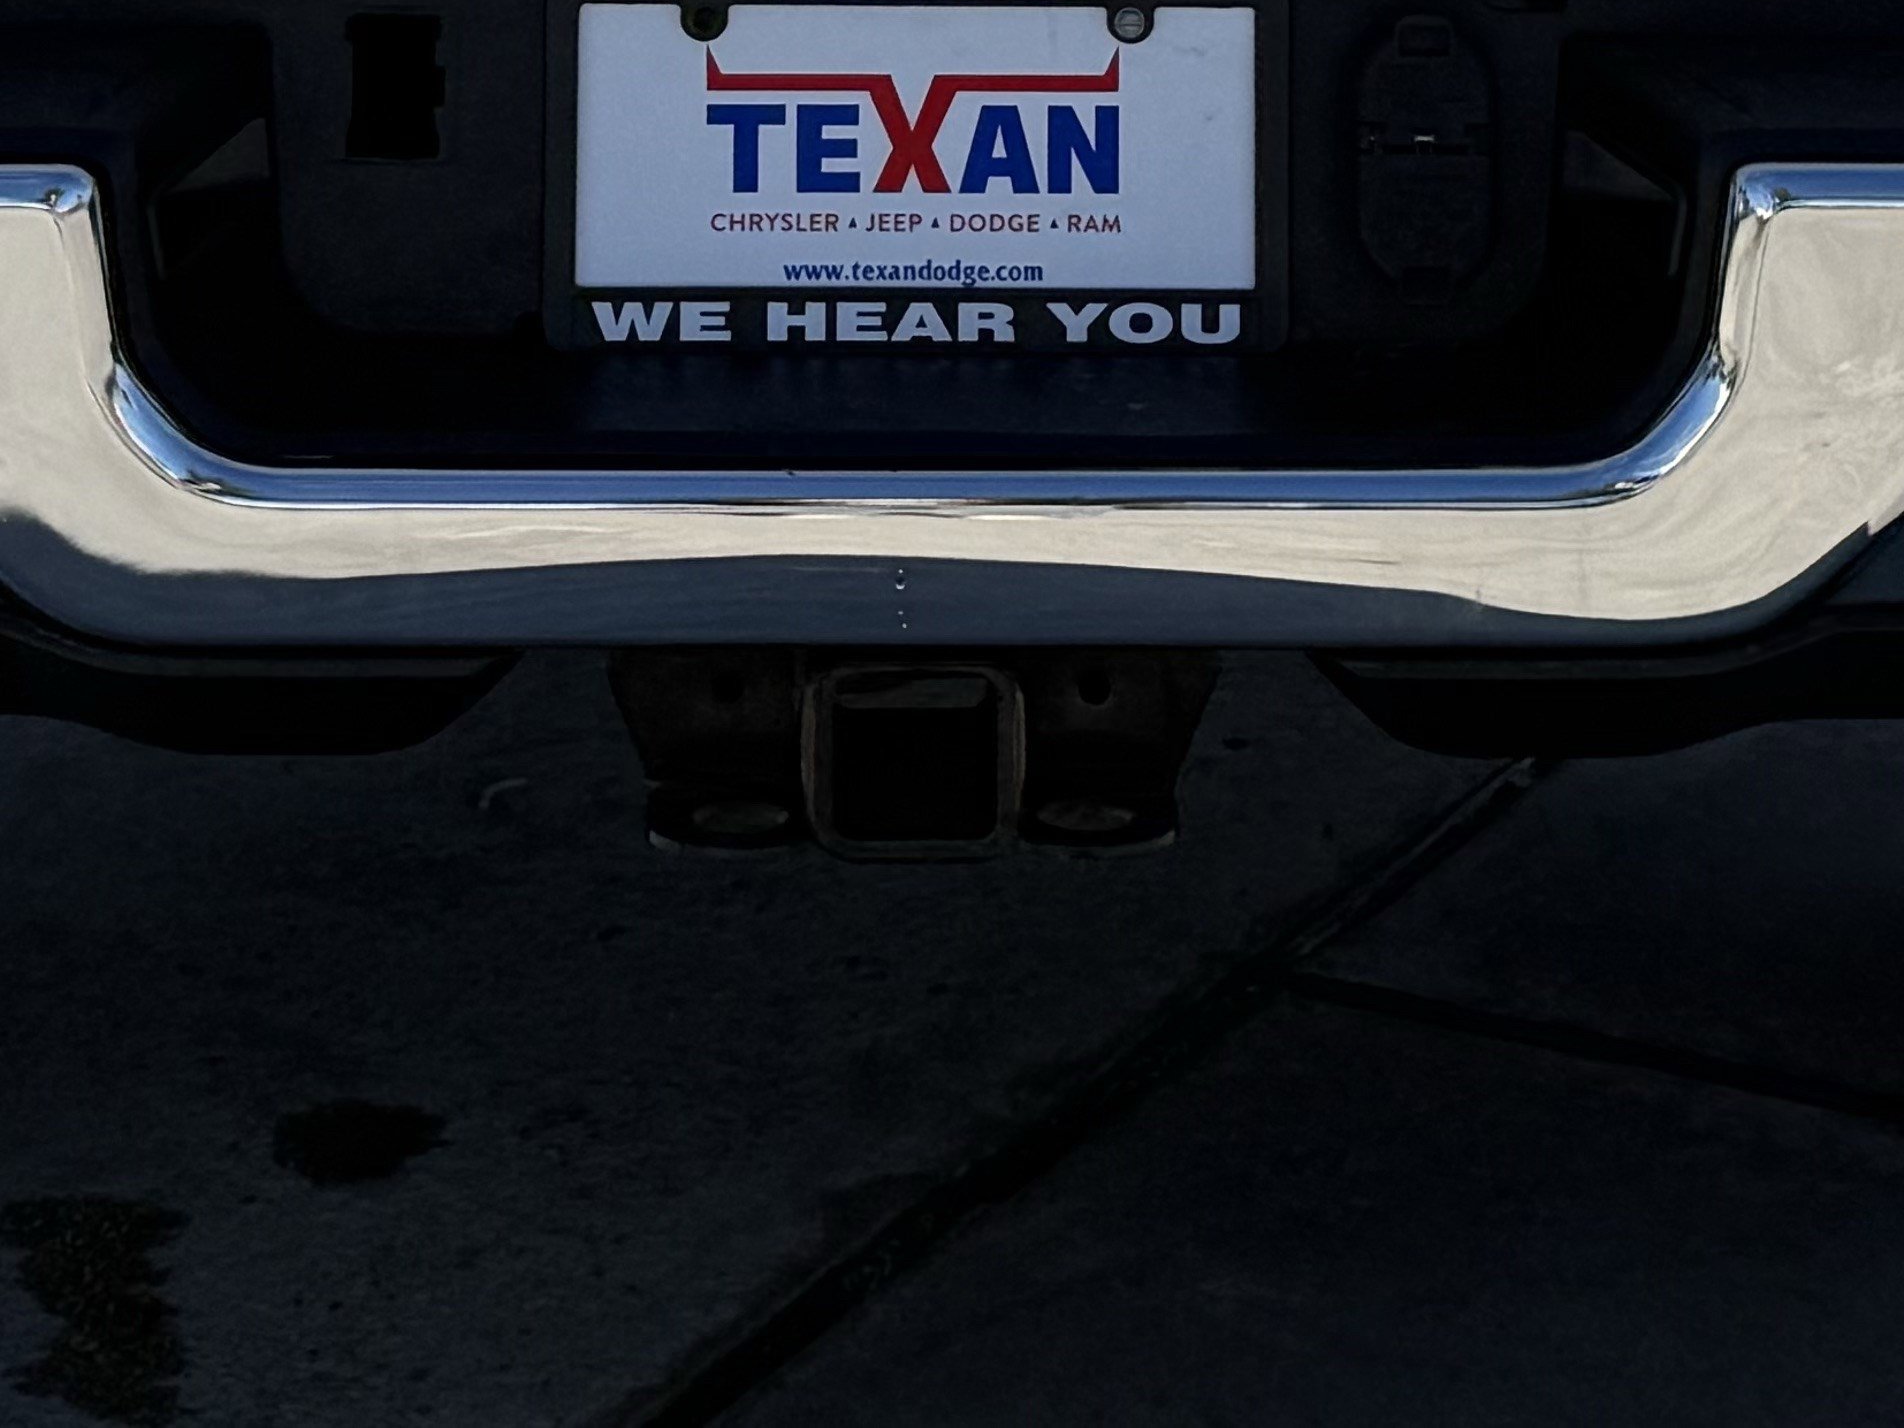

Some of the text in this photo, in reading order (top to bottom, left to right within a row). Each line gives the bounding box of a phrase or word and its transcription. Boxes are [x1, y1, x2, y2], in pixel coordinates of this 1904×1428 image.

[706, 72, 1120, 194] TEXAN
[709, 212, 1122, 234] CHRYSLER JEEP DODGE RAM
[783, 259, 1045, 288] www.texandodge.com
[592, 301, 1242, 344] WE HEAR YOU
